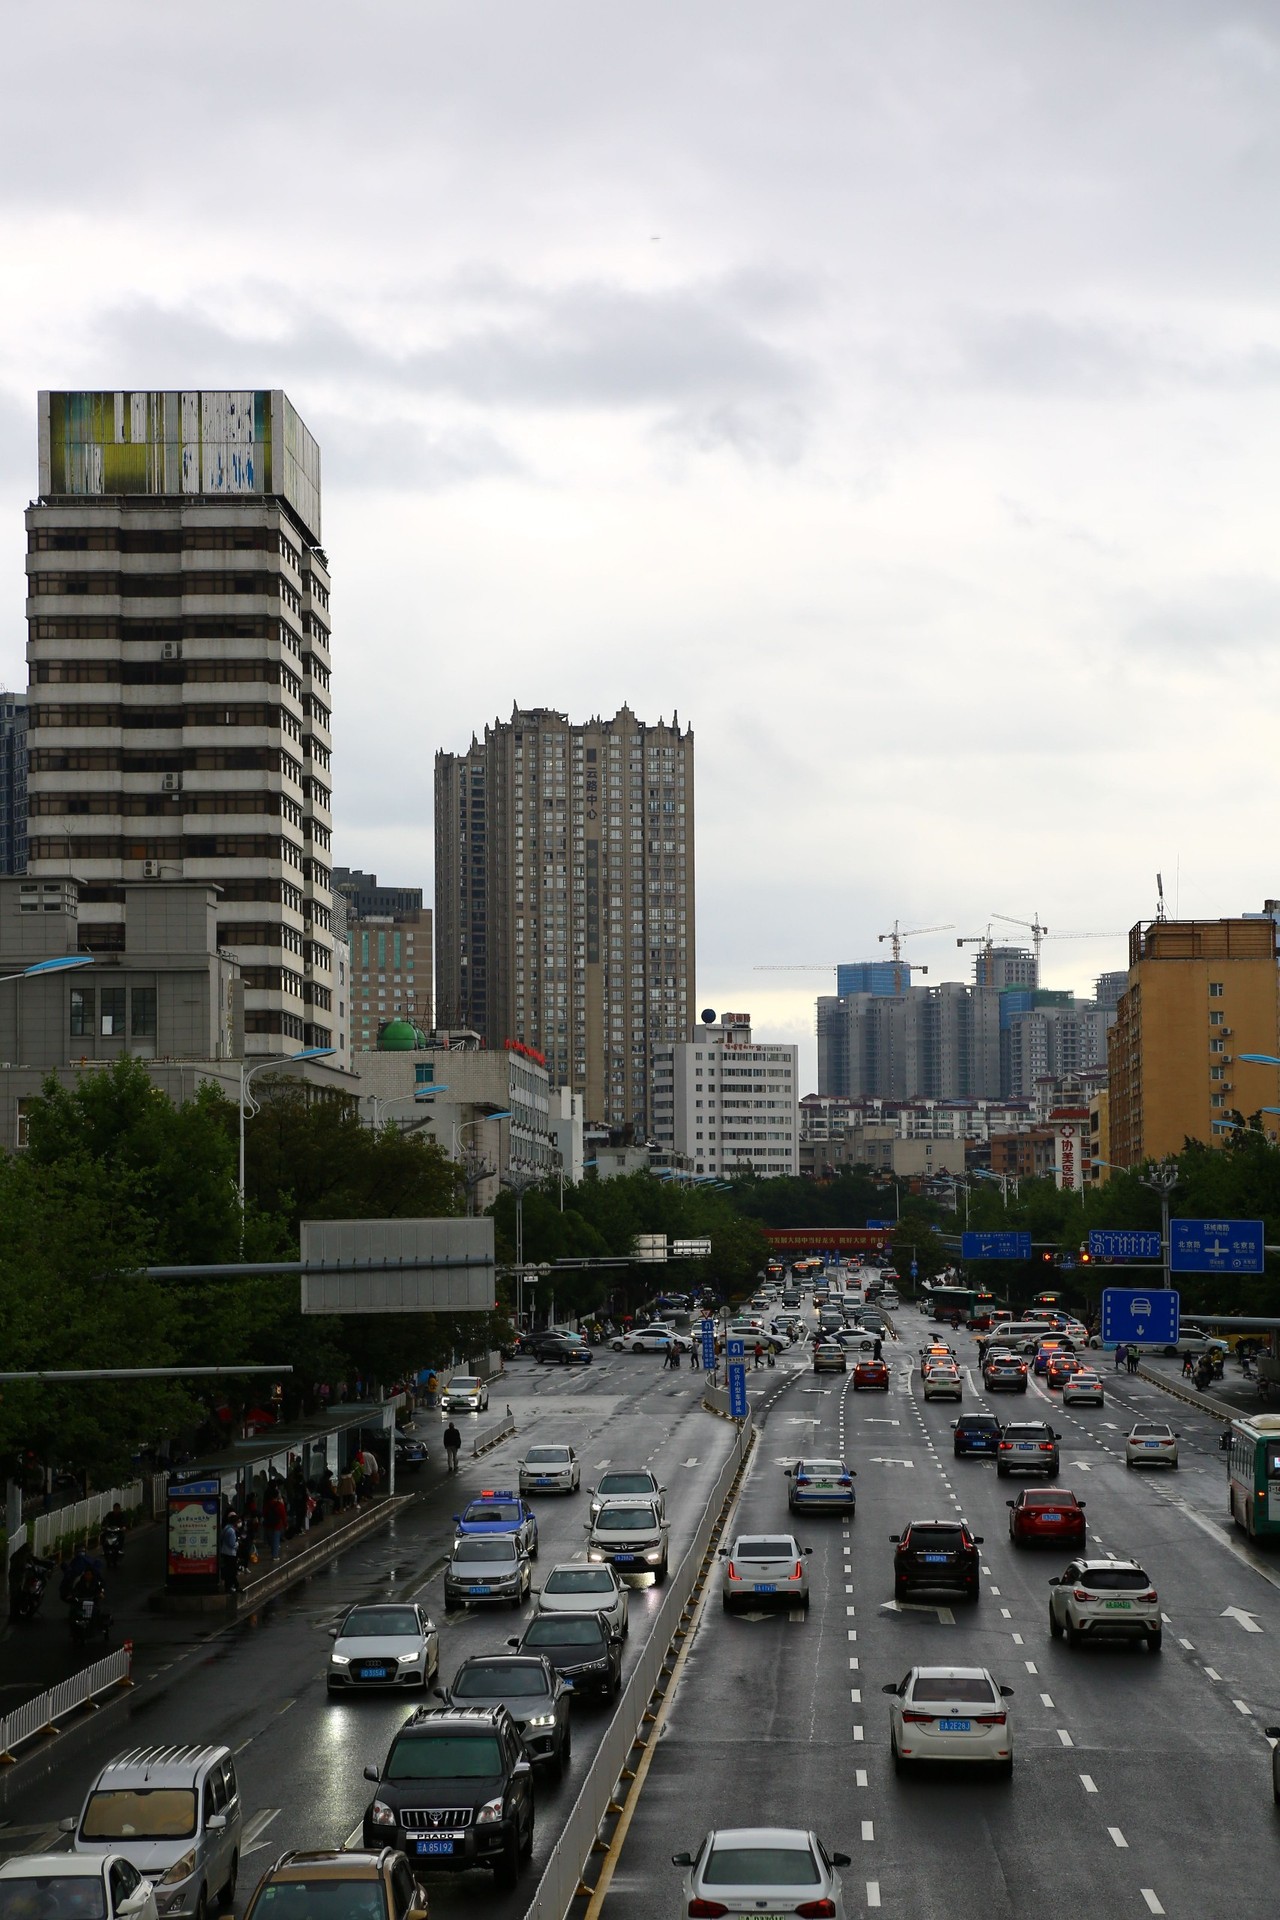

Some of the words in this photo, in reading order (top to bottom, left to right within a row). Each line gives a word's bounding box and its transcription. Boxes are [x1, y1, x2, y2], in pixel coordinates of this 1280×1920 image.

[1061, 1139, 1075, 1188] 协美医院
[1178, 1240, 1201, 1248] 北京路
[1233, 1241, 1256, 1250] 北京路
